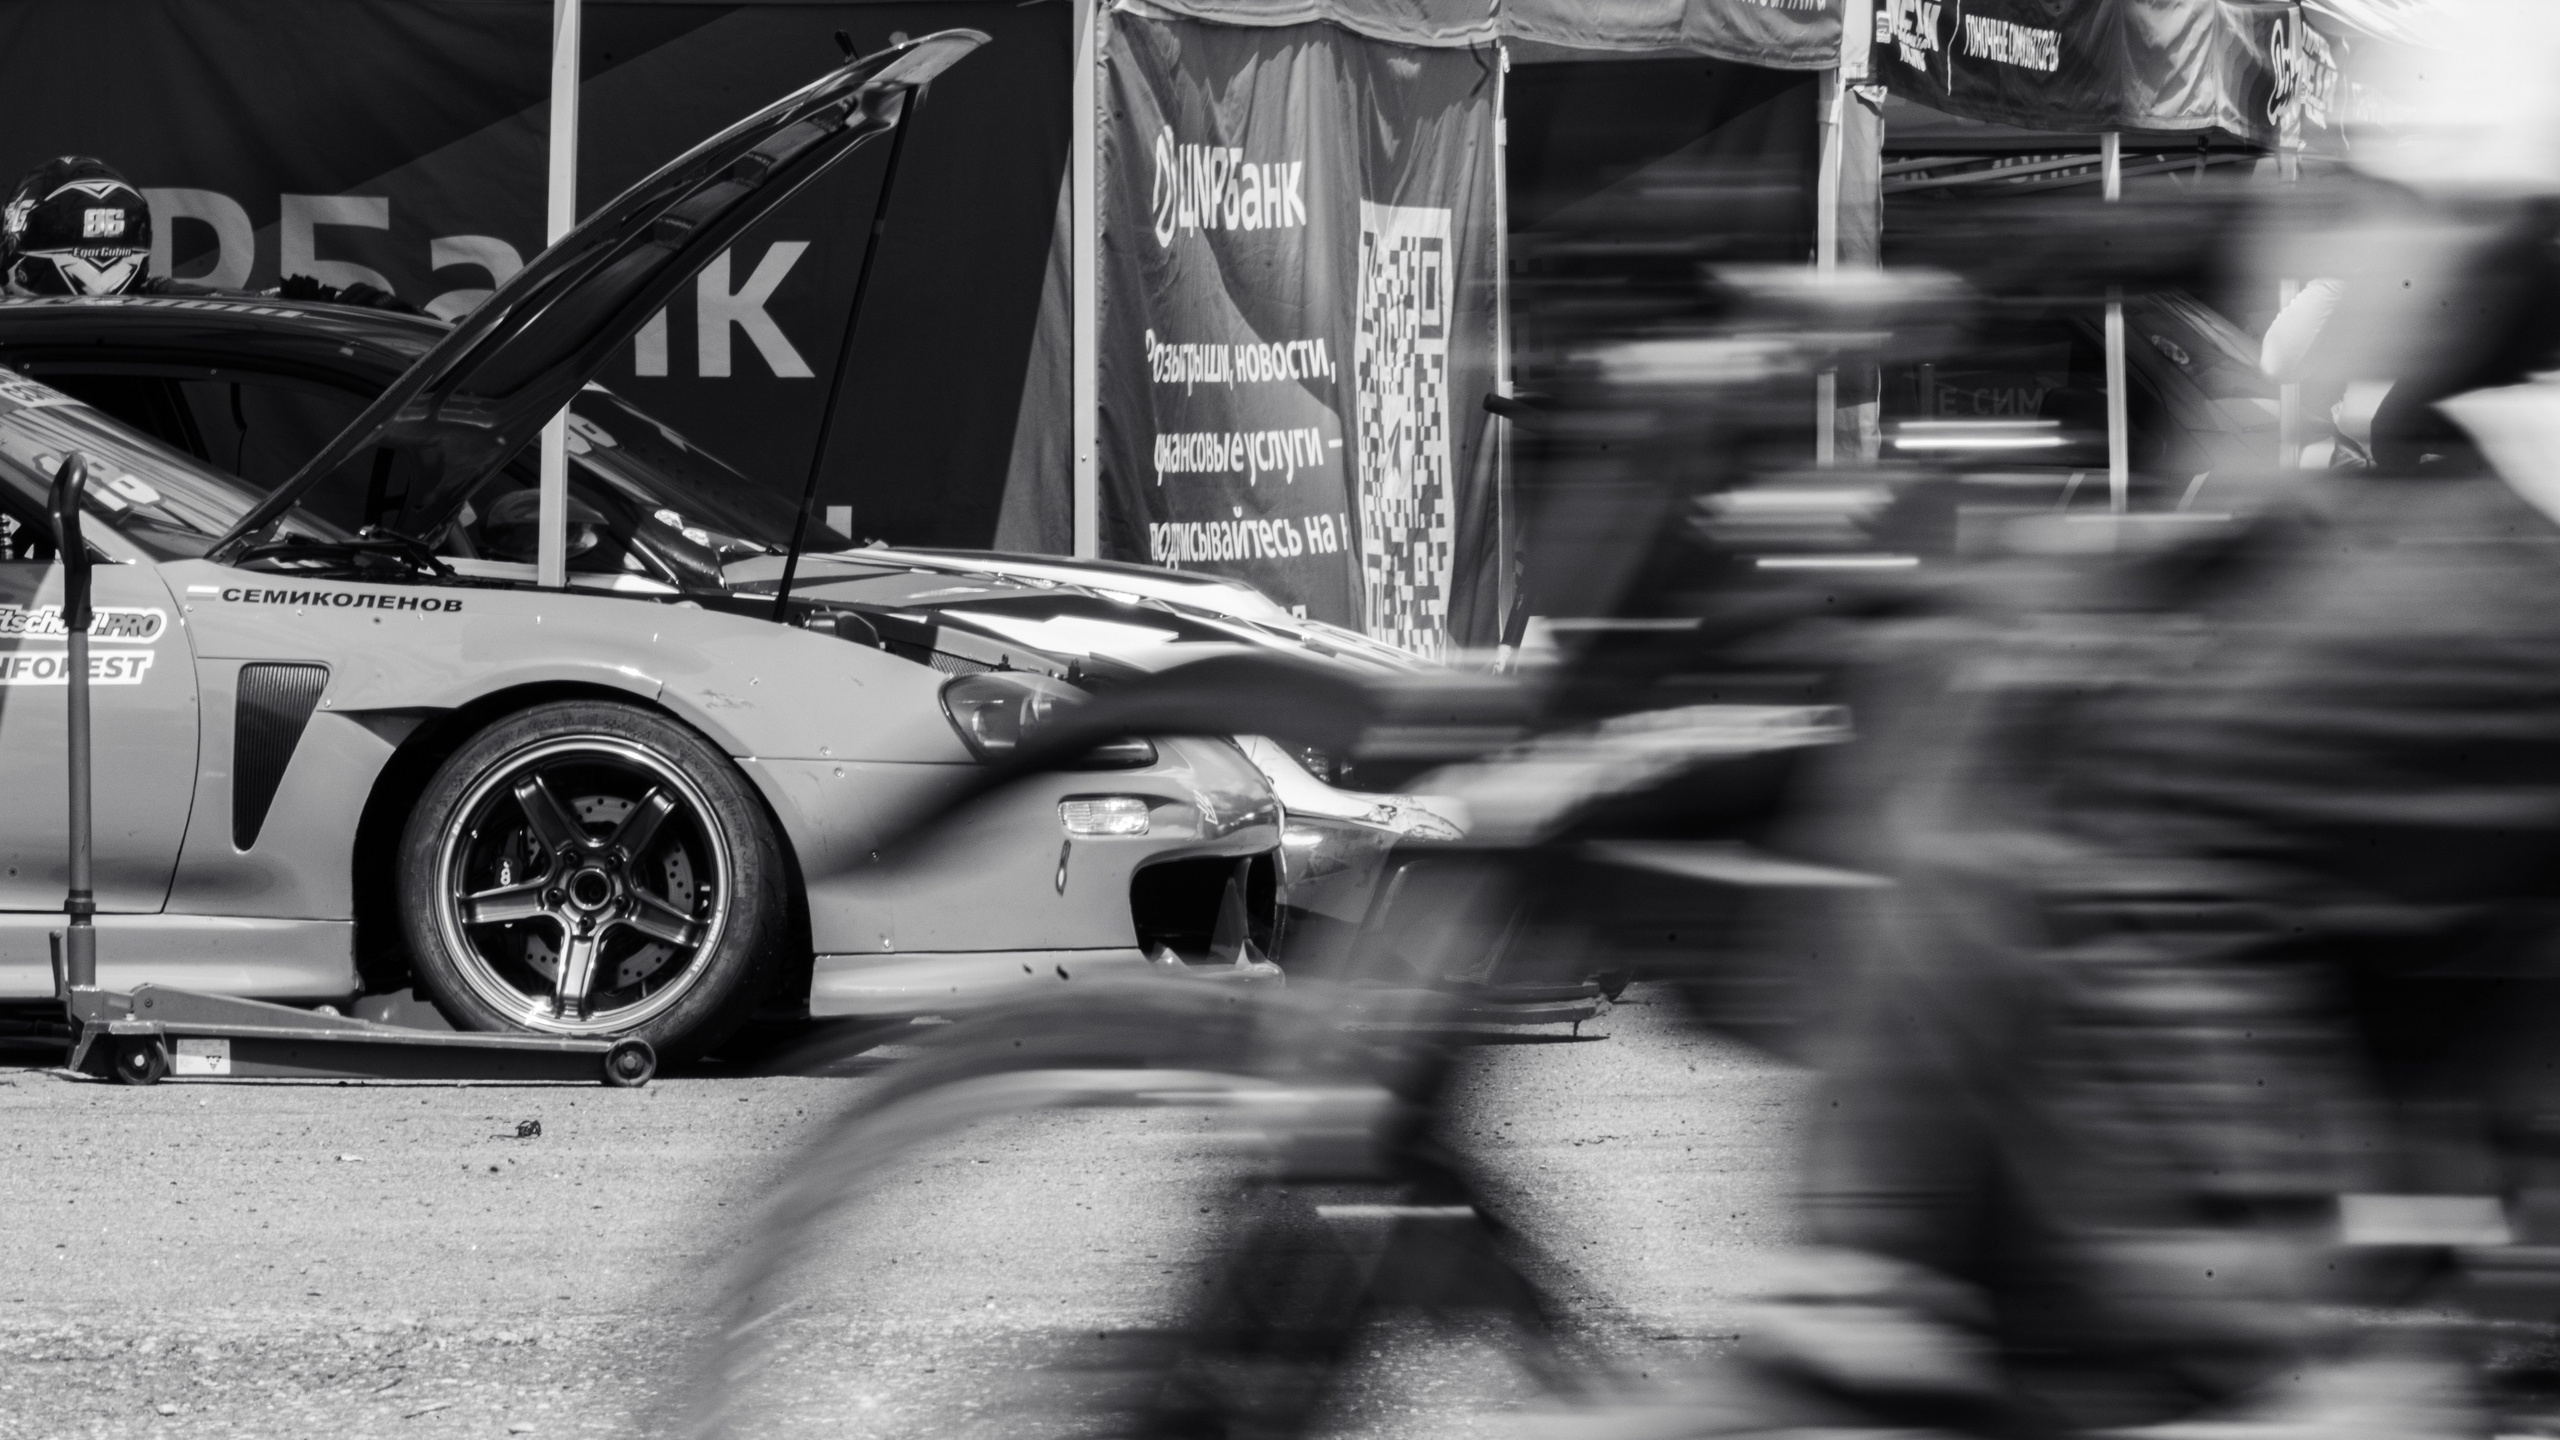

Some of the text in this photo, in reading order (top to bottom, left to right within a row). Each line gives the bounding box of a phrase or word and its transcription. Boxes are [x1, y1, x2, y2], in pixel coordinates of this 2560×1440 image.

[1234, 337, 1336, 385] новости,
[1243, 427, 1324, 487] услуги
[1303, 513, 1338, 554] на
[222, 588, 463, 613] СЕМИКОЛЕНОВ
